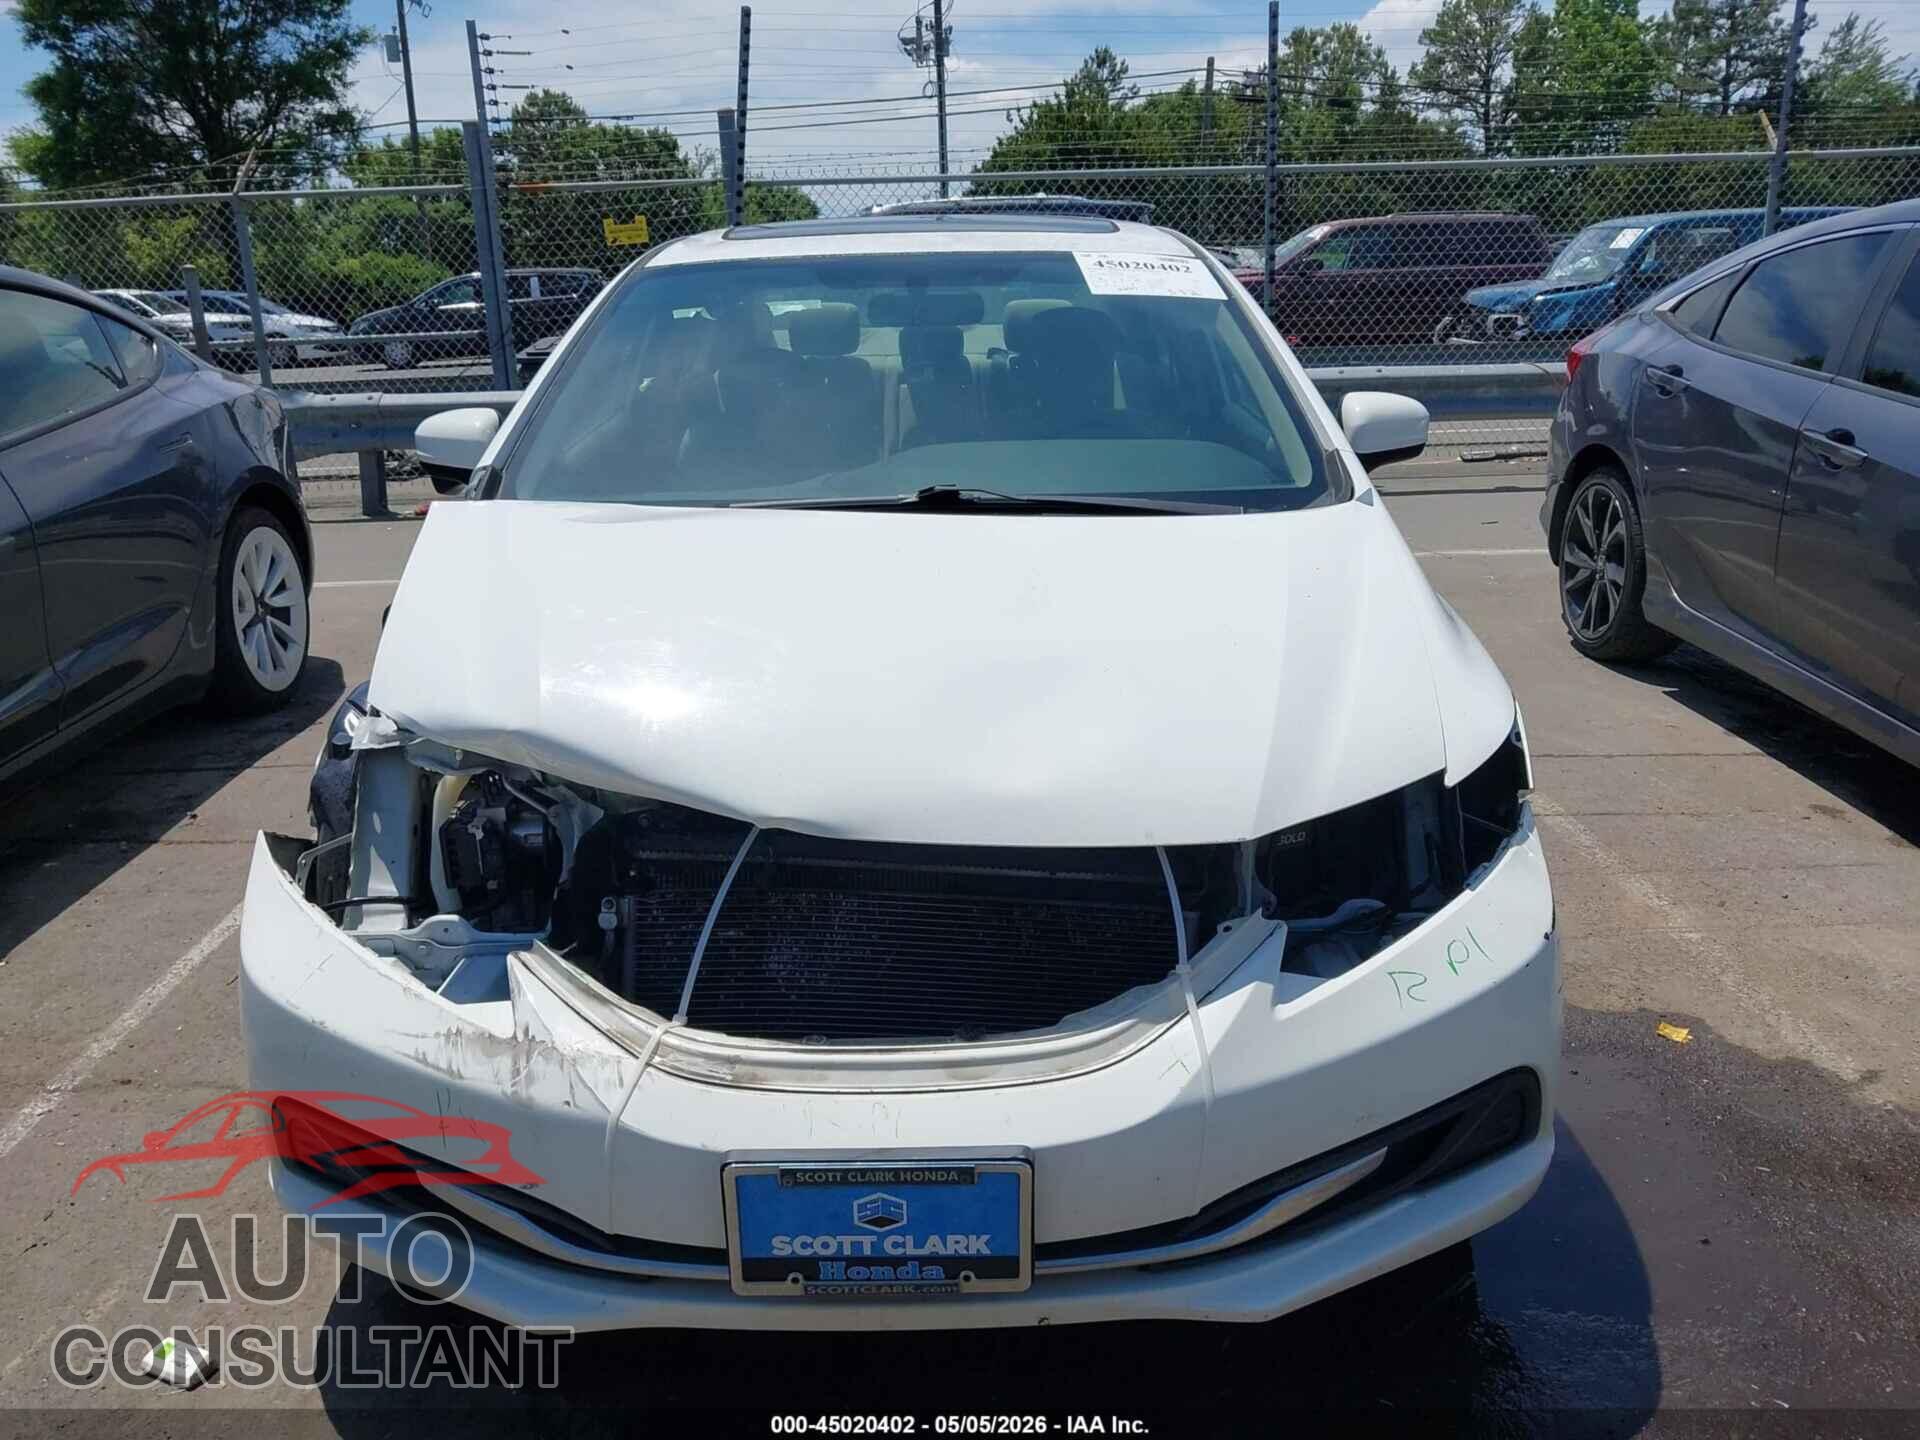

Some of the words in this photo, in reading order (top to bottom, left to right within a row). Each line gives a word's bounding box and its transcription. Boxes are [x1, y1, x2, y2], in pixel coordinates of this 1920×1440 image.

[1092, 259, 1193, 274] 45020402
[795, 1171, 842, 1183] SCOTT
[847, 1171, 895, 1183] CLARK
[899, 1170, 959, 1182] HONDA
[771, 1234, 878, 1257] SCOTT
[882, 1233, 992, 1256] CLARK
[818, 1260, 945, 1281] Honda
